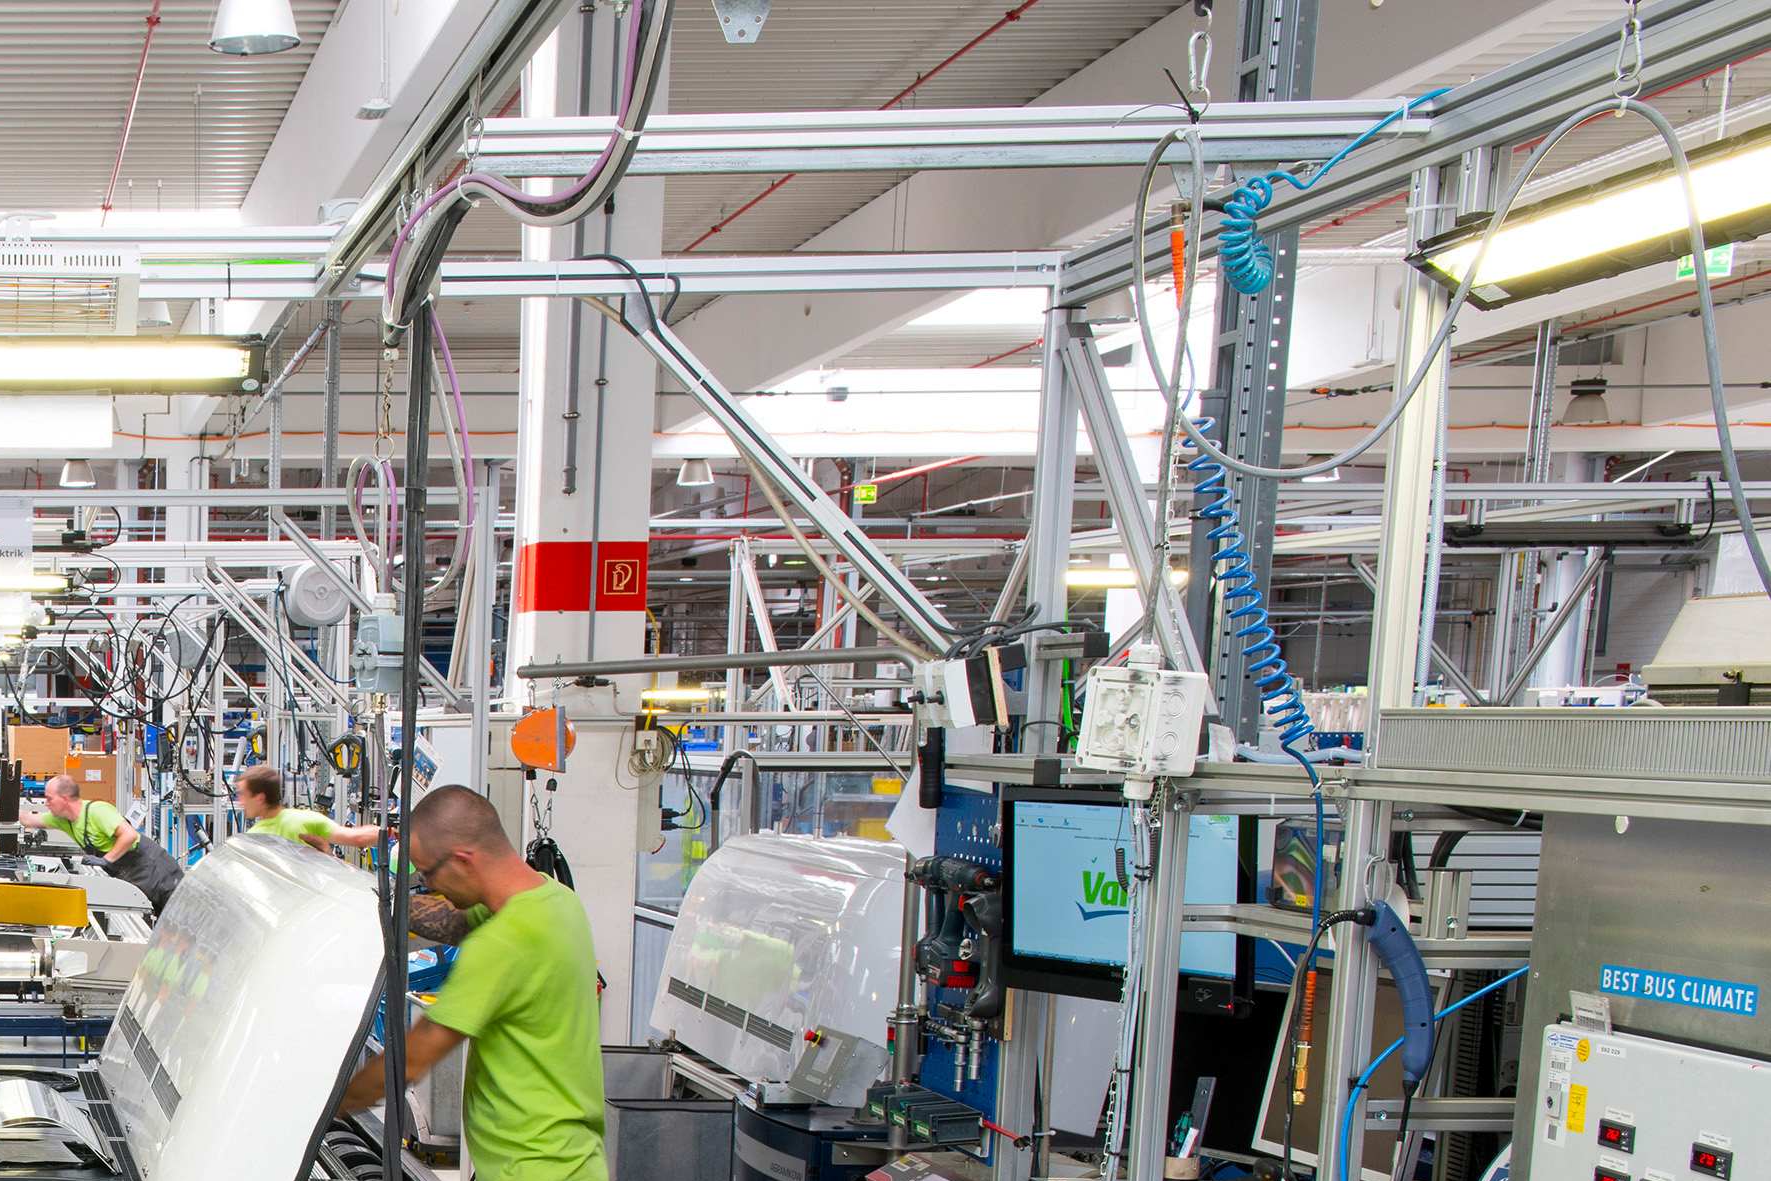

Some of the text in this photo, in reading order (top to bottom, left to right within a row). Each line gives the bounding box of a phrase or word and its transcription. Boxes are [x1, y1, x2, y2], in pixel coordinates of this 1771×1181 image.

[1082, 869, 1129, 907] Val
[1602, 968, 1755, 1012] BEST BUS CLIMATE
